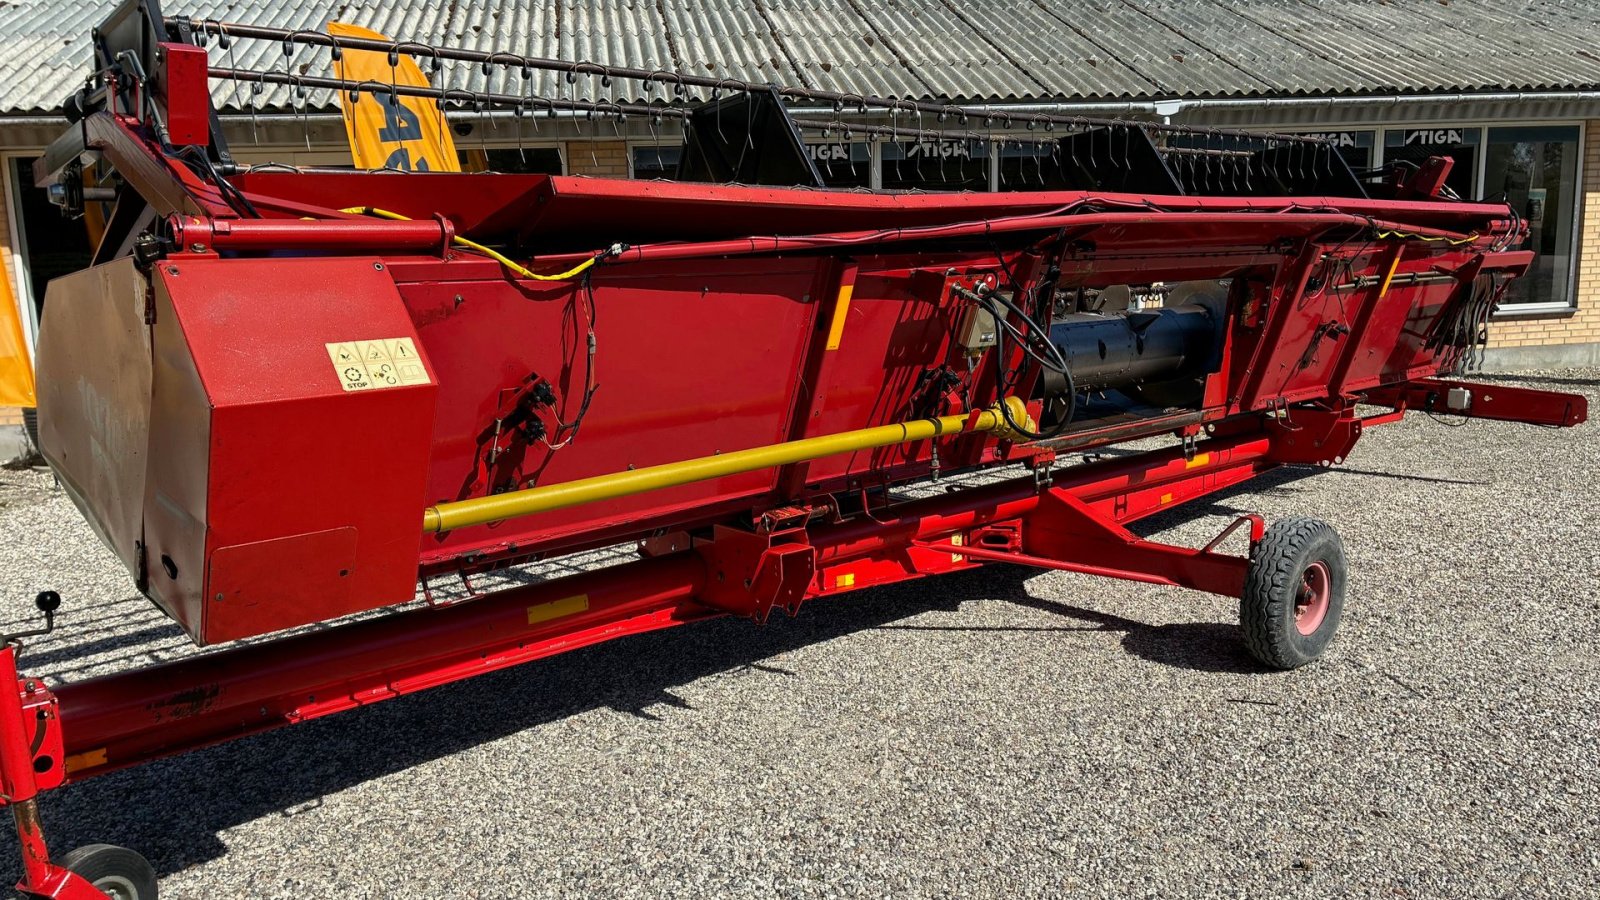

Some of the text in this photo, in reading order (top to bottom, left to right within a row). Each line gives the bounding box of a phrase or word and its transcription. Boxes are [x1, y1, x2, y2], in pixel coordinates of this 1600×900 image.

[1405, 130, 1462, 145] STIGA
[805, 145, 848, 160] IGA
[907, 142, 969, 158] STIGA
